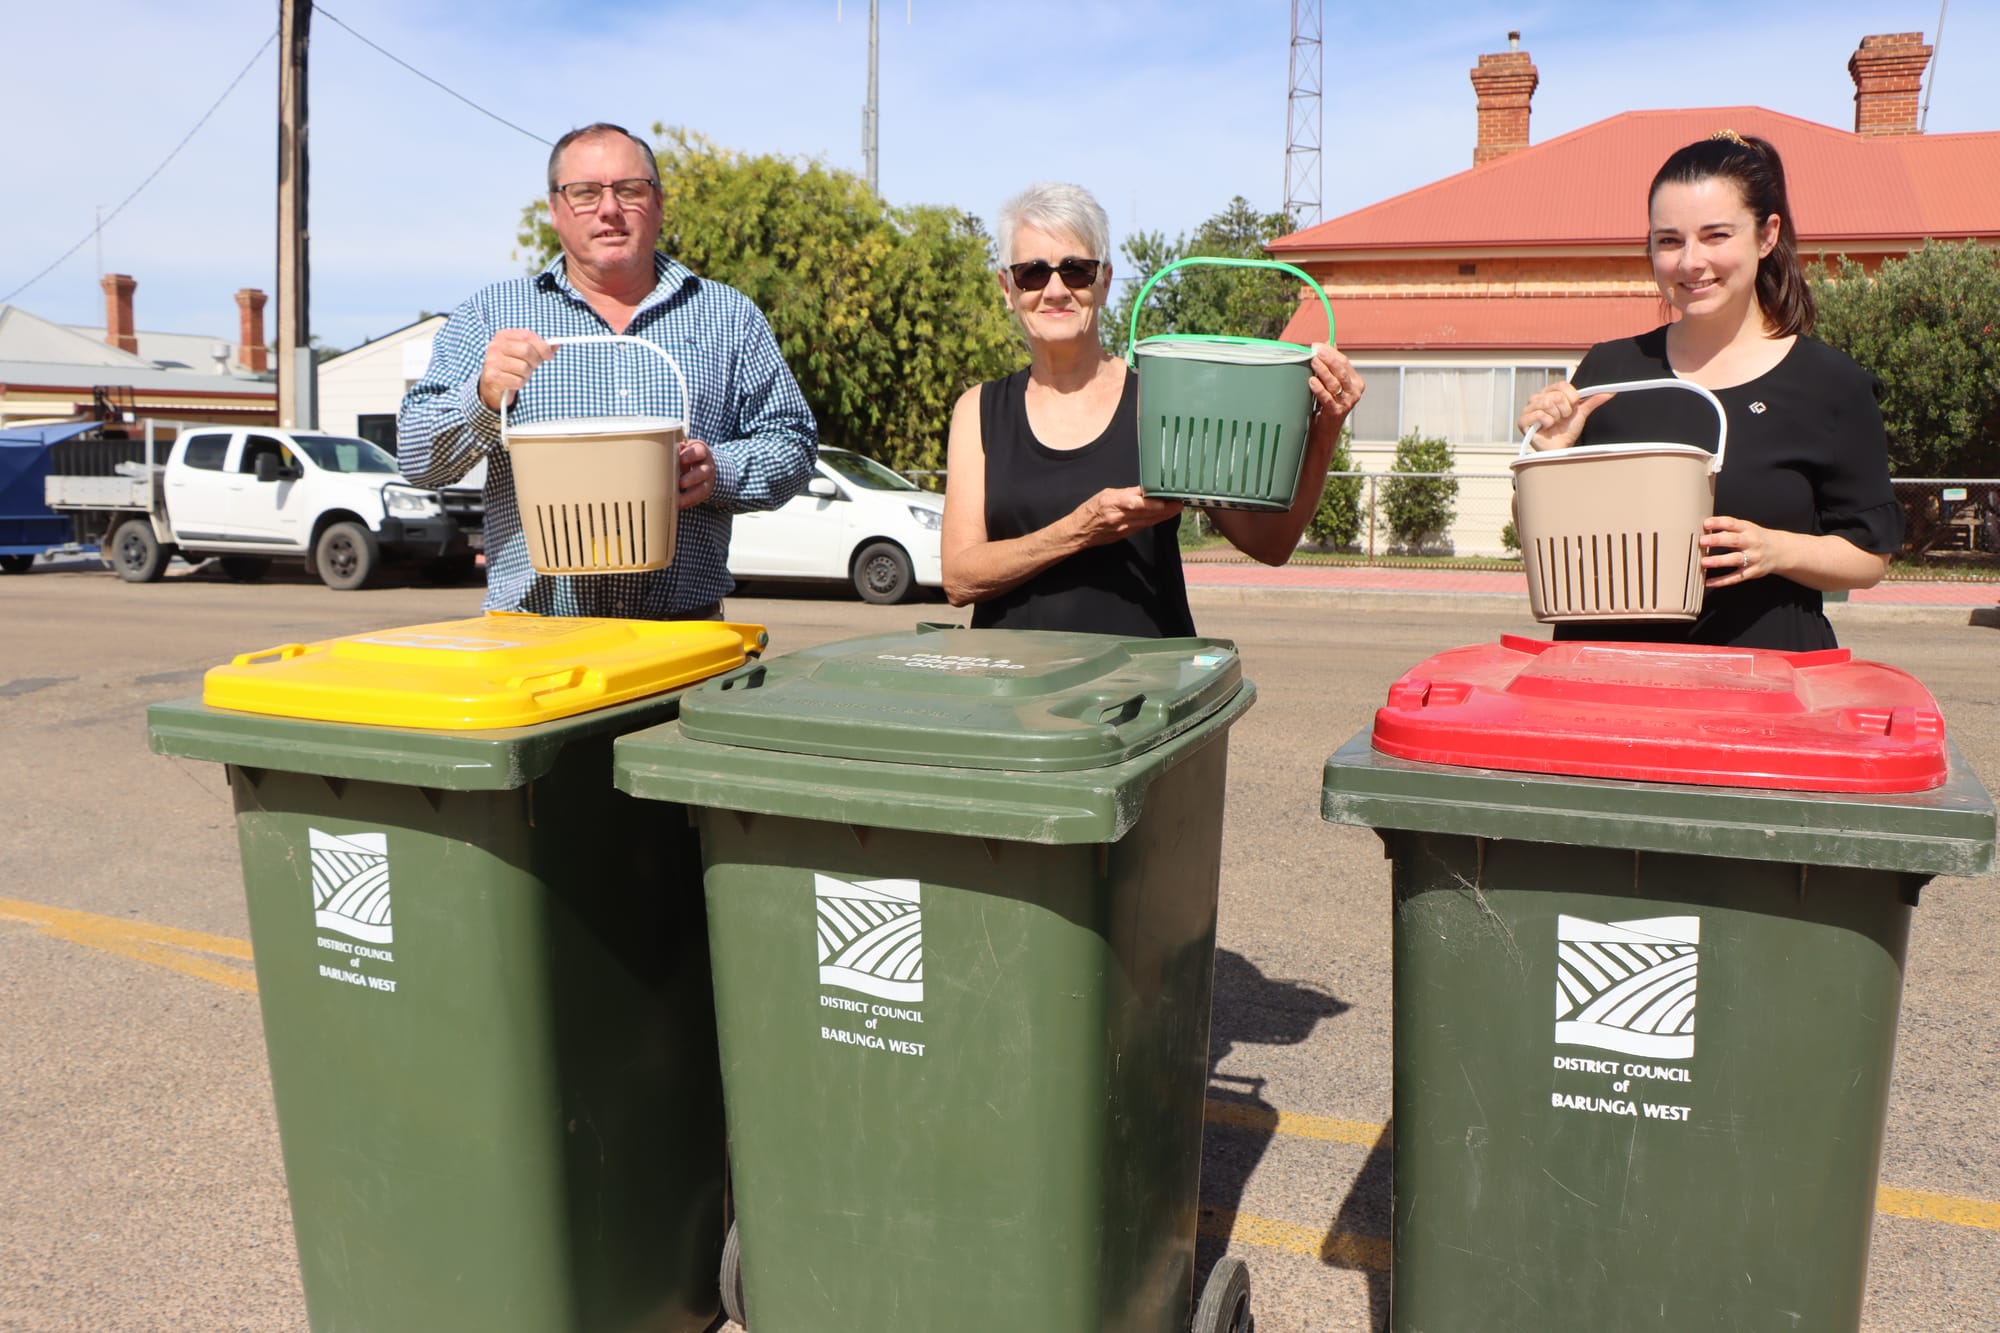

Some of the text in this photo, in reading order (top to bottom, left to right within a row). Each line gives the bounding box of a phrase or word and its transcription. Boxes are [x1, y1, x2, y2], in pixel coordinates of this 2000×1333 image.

[876, 654, 1026, 670] CARDBOARD
[317, 937, 394, 962] DISTRICT COUNCIL
[350, 957, 361, 968] of
[319, 965, 397, 992] BARUNGA WEST
[820, 995, 924, 1023] DISTRICT COUNCIL
[865, 1018, 878, 1030] of
[821, 1027, 925, 1056] BARUNGA WEST
[1553, 1056, 1692, 1082] DISTRICT COUNCIL
[1613, 1080, 1630, 1093] of
[1551, 1093, 1692, 1121] BARUNGA WEST
